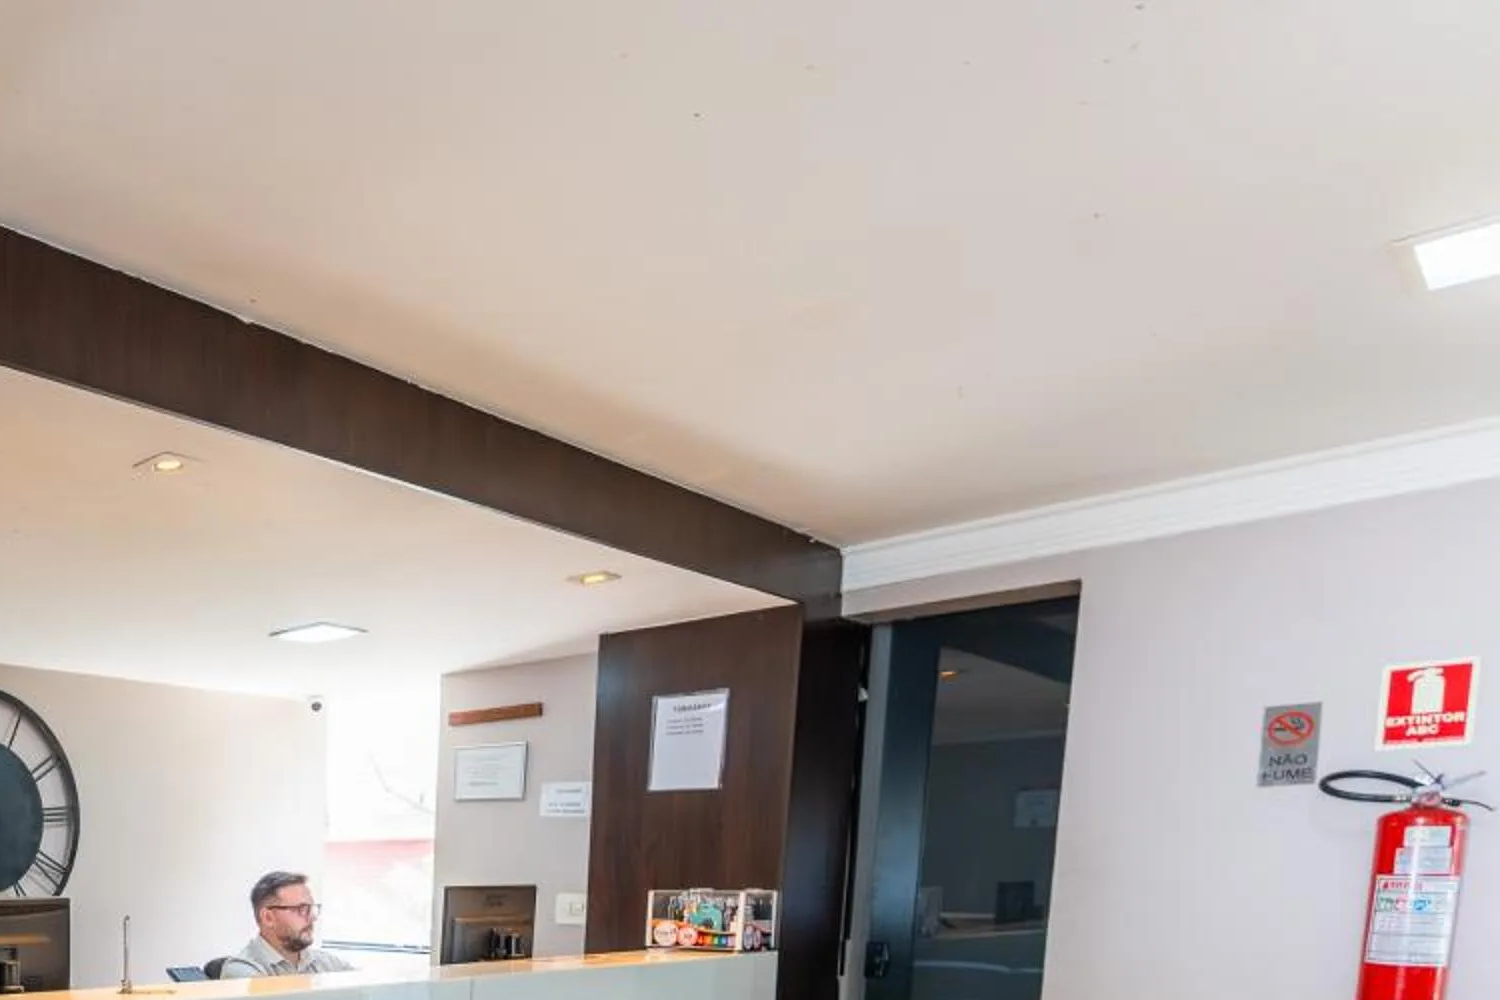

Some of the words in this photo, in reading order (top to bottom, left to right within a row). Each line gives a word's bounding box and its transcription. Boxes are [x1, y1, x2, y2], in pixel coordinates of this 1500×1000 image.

[1384, 711, 1467, 728] EXTINTOR
[1268, 752, 1309, 767] NÃO
[1261, 767, 1313, 783] FUME
